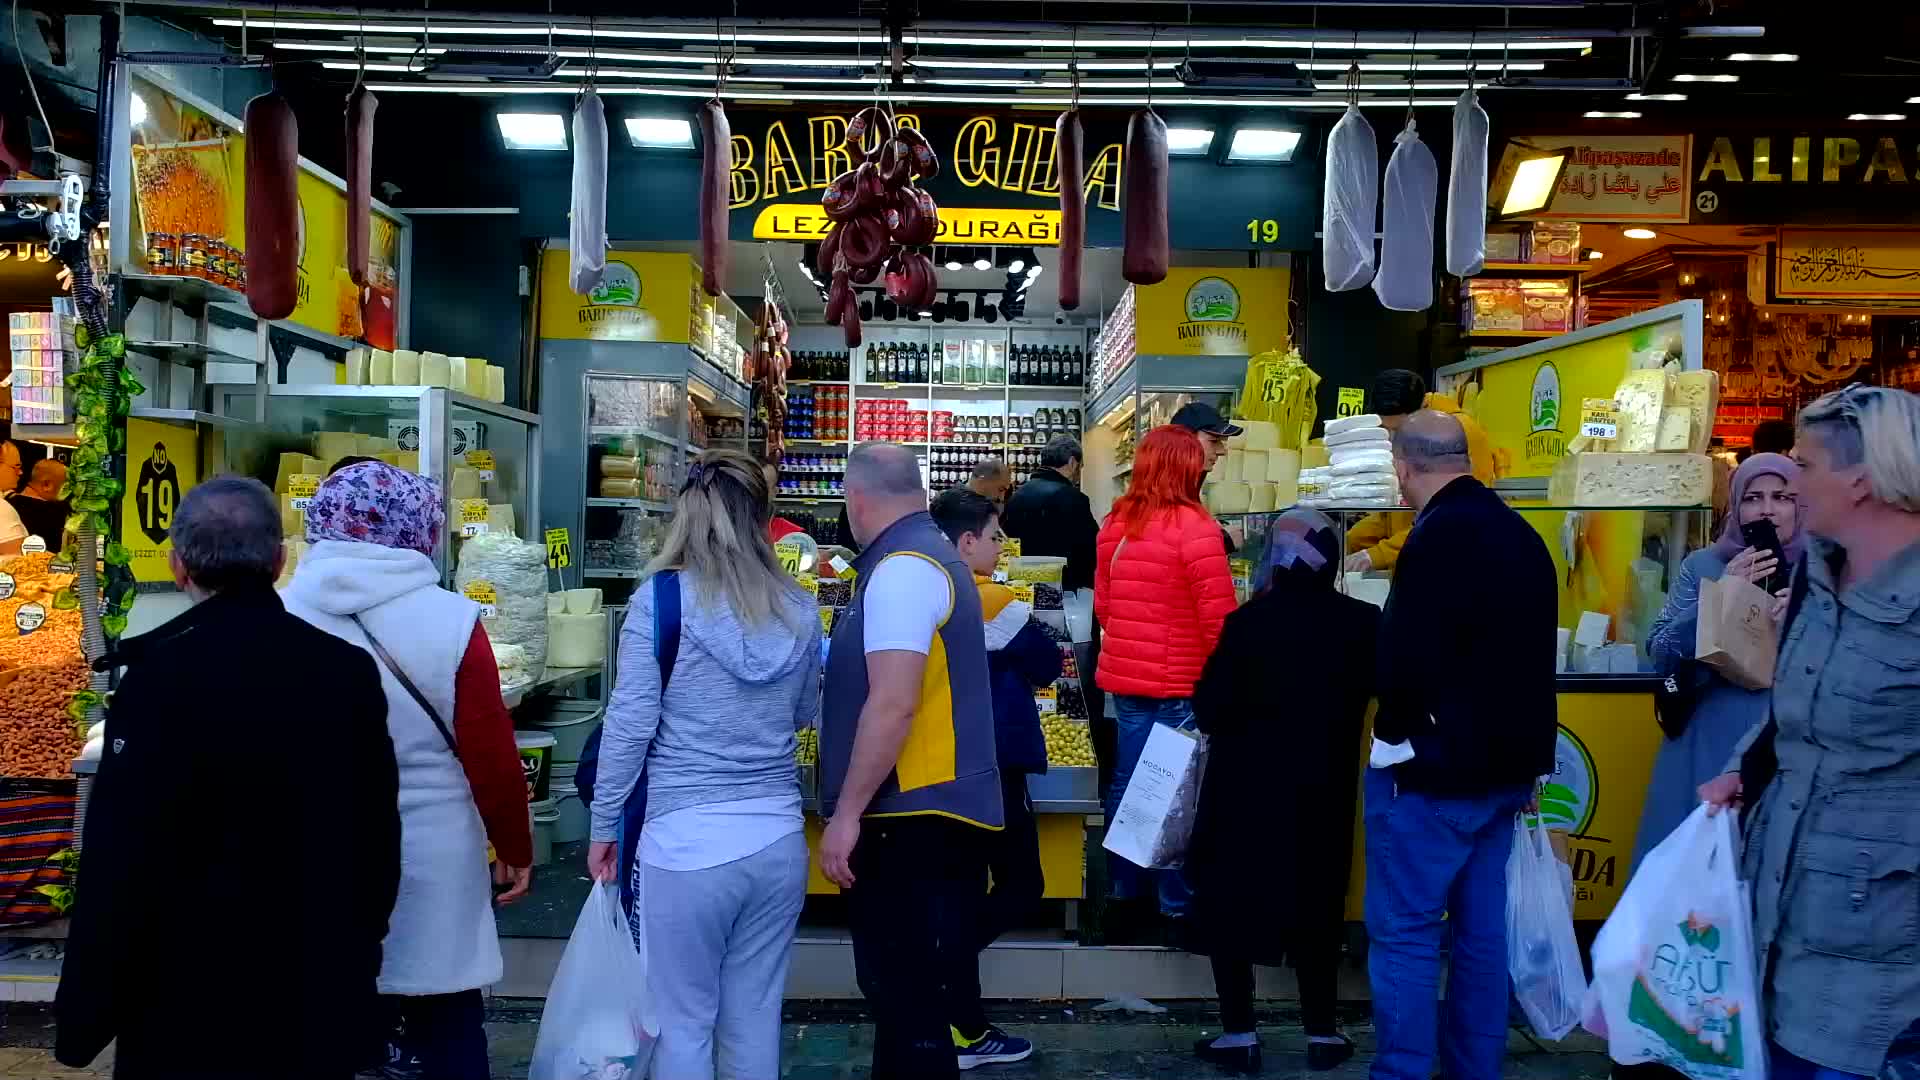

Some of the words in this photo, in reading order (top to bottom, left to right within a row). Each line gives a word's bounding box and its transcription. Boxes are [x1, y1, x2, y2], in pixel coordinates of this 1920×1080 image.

[1698, 136, 1920, 183] ALIPA
[1699, 194, 1715, 209] 21
[1247, 219, 1279, 243] 19
[1588, 427, 1606, 437] 198
[153, 448, 166, 464] NO
[141, 478, 173, 530] 19
[134, 549, 157, 559] EZZET
[550, 543, 571, 568] 49
